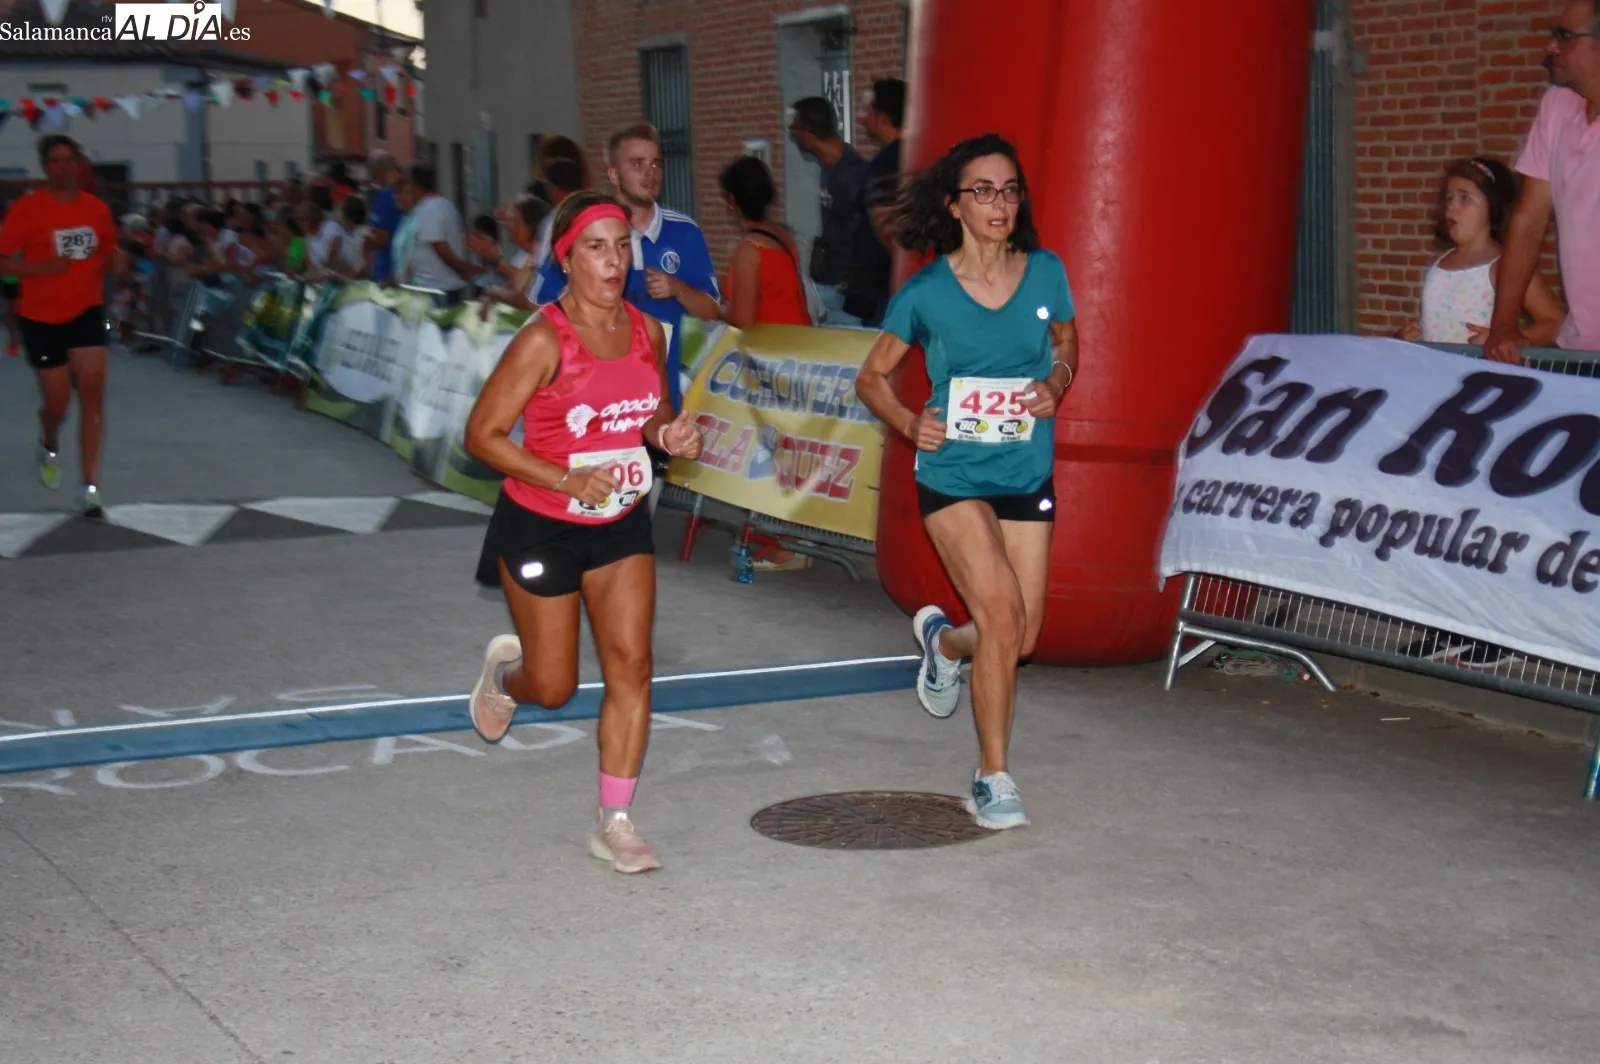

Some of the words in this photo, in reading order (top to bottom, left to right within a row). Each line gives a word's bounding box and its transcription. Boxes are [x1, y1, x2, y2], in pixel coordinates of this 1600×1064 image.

[959, 390, 1028, 416] 425
[1185, 356, 1388, 463] San
[1377, 371, 1600, 516] Ro
[1181, 479, 1321, 529] carrera
[1319, 498, 1530, 574] popular
[1535, 531, 1600, 594] de
